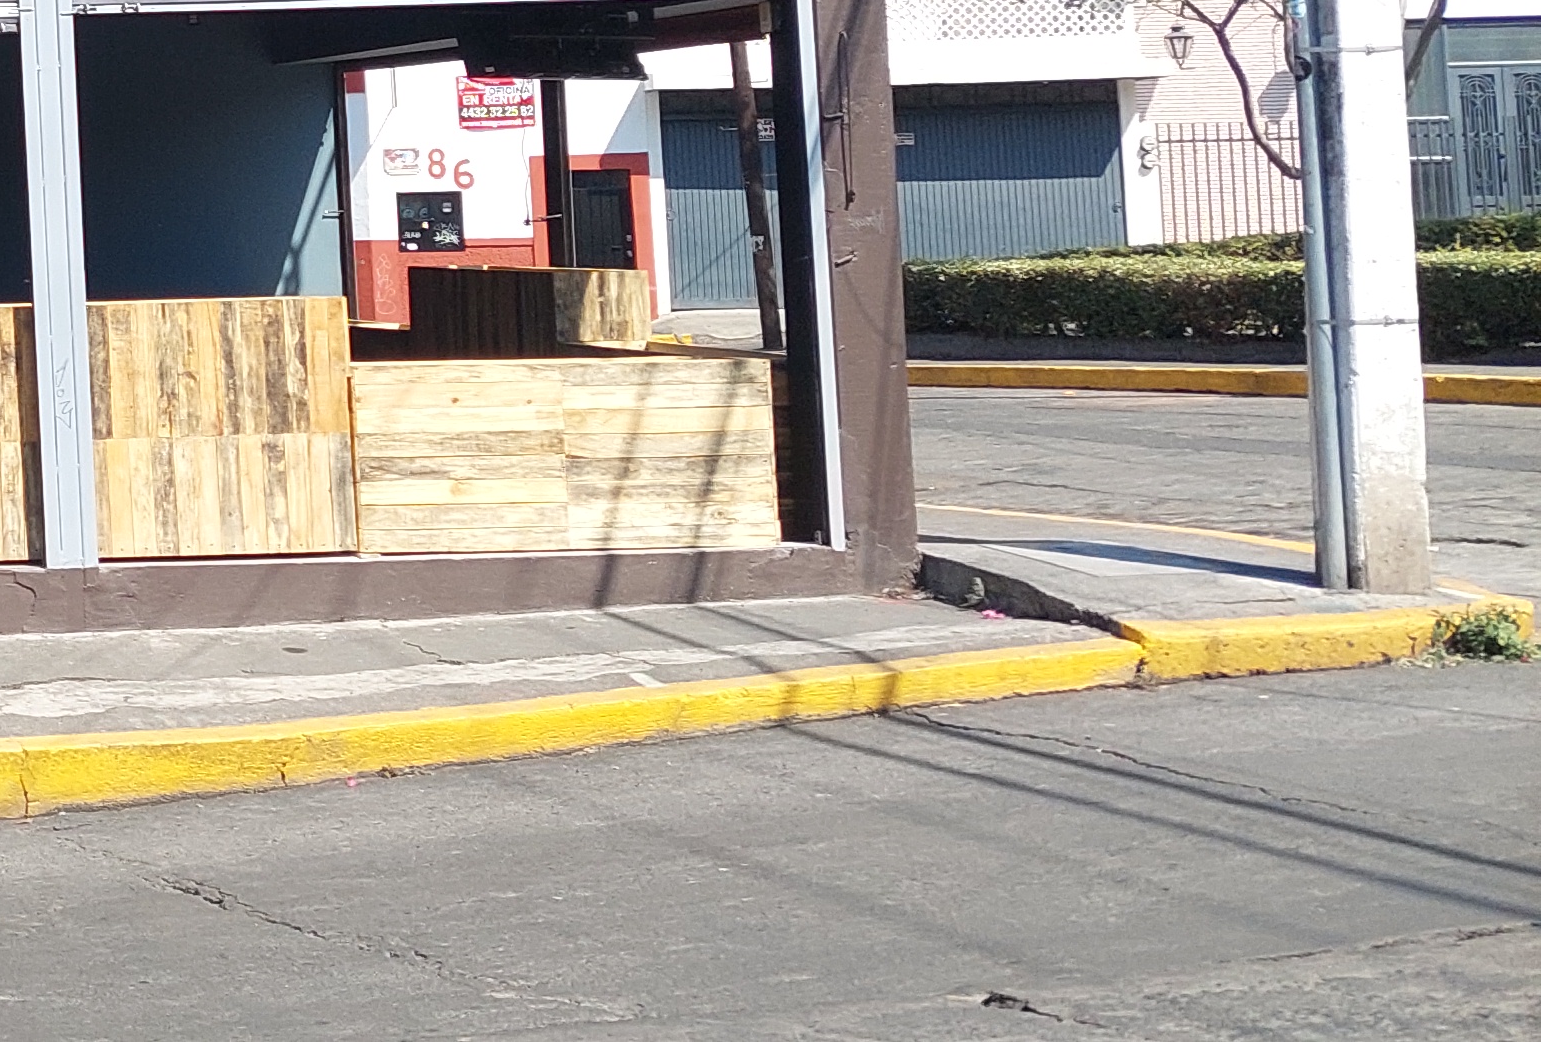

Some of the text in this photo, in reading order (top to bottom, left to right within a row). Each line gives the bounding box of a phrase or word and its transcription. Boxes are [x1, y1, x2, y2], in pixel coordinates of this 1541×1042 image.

[488, 86, 530, 95] OFICINA
[462, 95, 521, 106] EN RENTA
[428, 148, 475, 190] 86
